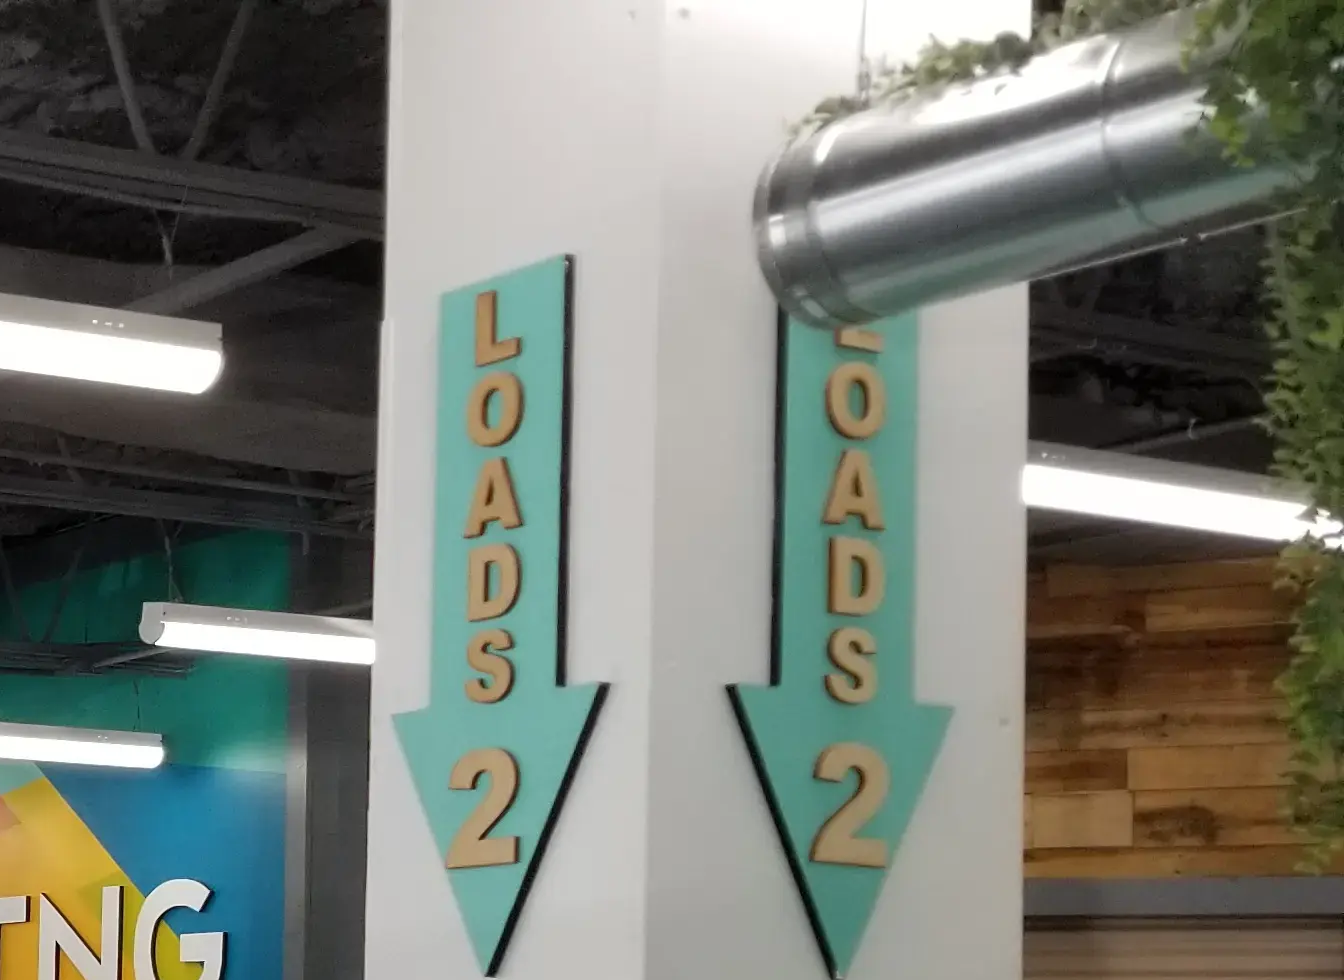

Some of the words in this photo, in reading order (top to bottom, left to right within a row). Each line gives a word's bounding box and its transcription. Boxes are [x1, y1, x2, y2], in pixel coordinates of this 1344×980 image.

[463, 290, 525, 705] LOADS
[822, 324, 887, 705] OADS
[445, 747, 522, 870] 2
[809, 742, 892, 870] 2
